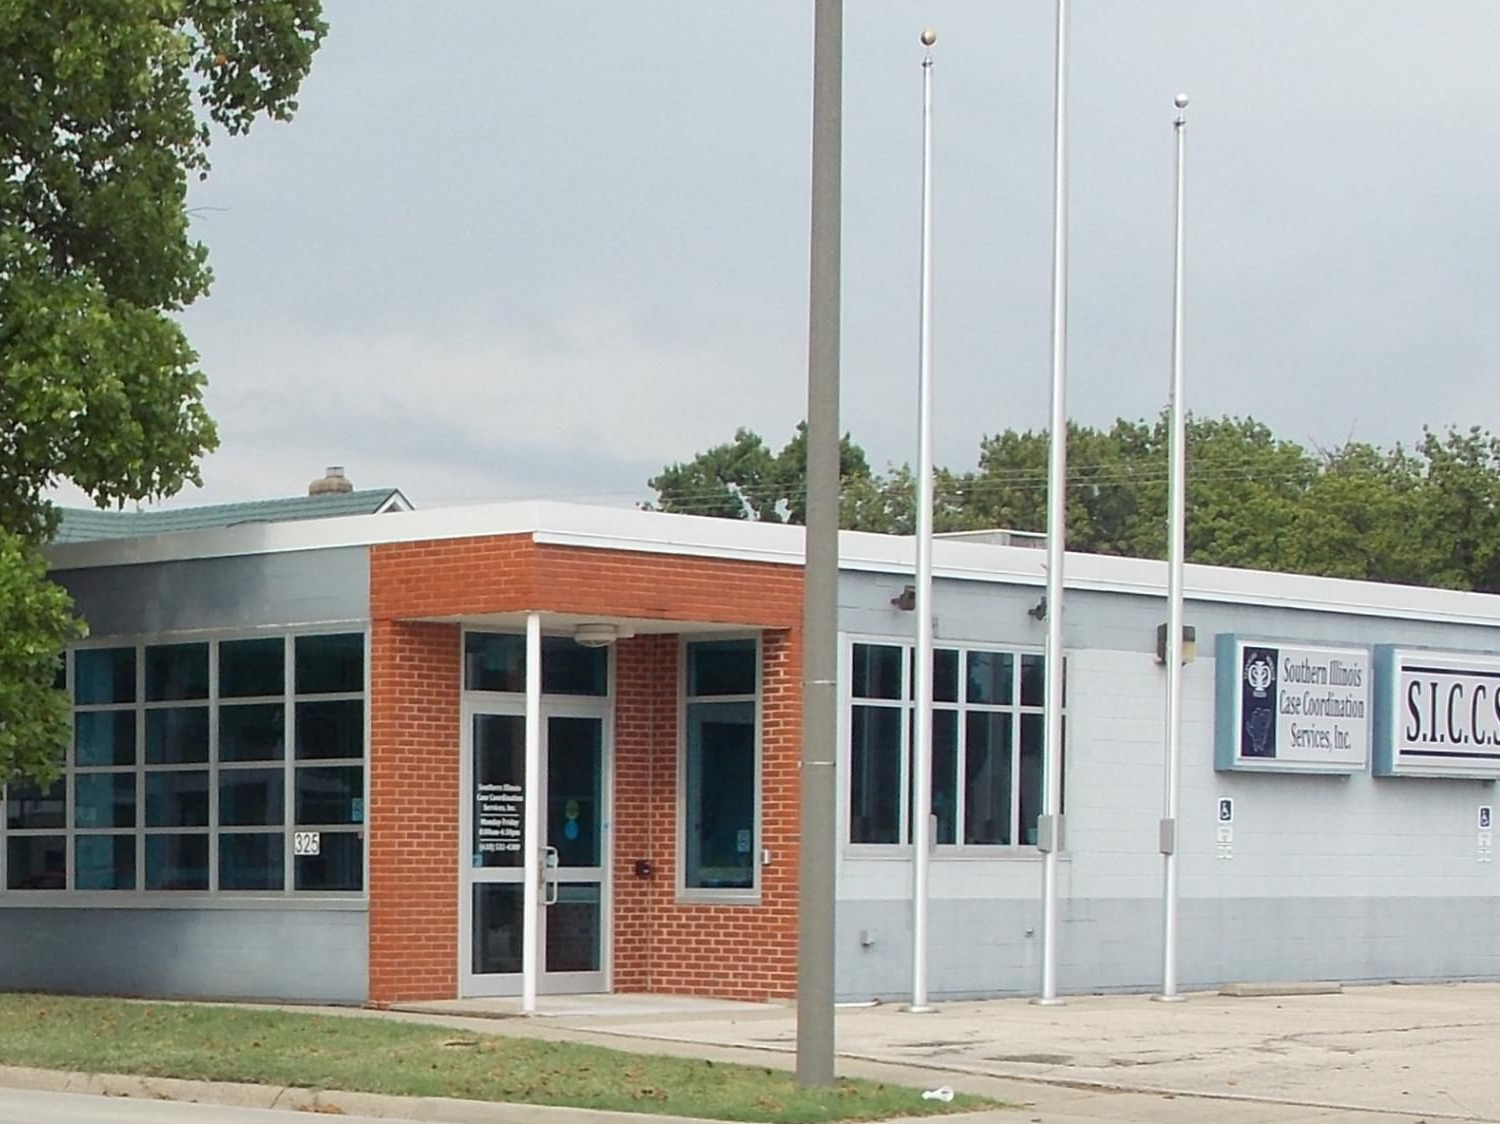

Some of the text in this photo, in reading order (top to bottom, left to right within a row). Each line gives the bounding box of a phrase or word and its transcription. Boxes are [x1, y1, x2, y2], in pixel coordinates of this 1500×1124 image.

[1284, 657, 1327, 685] Southern
[1329, 660, 1361, 687] Illinois
[1280, 689, 1364, 718] Case Coordination
[296, 833, 318, 853] 325
